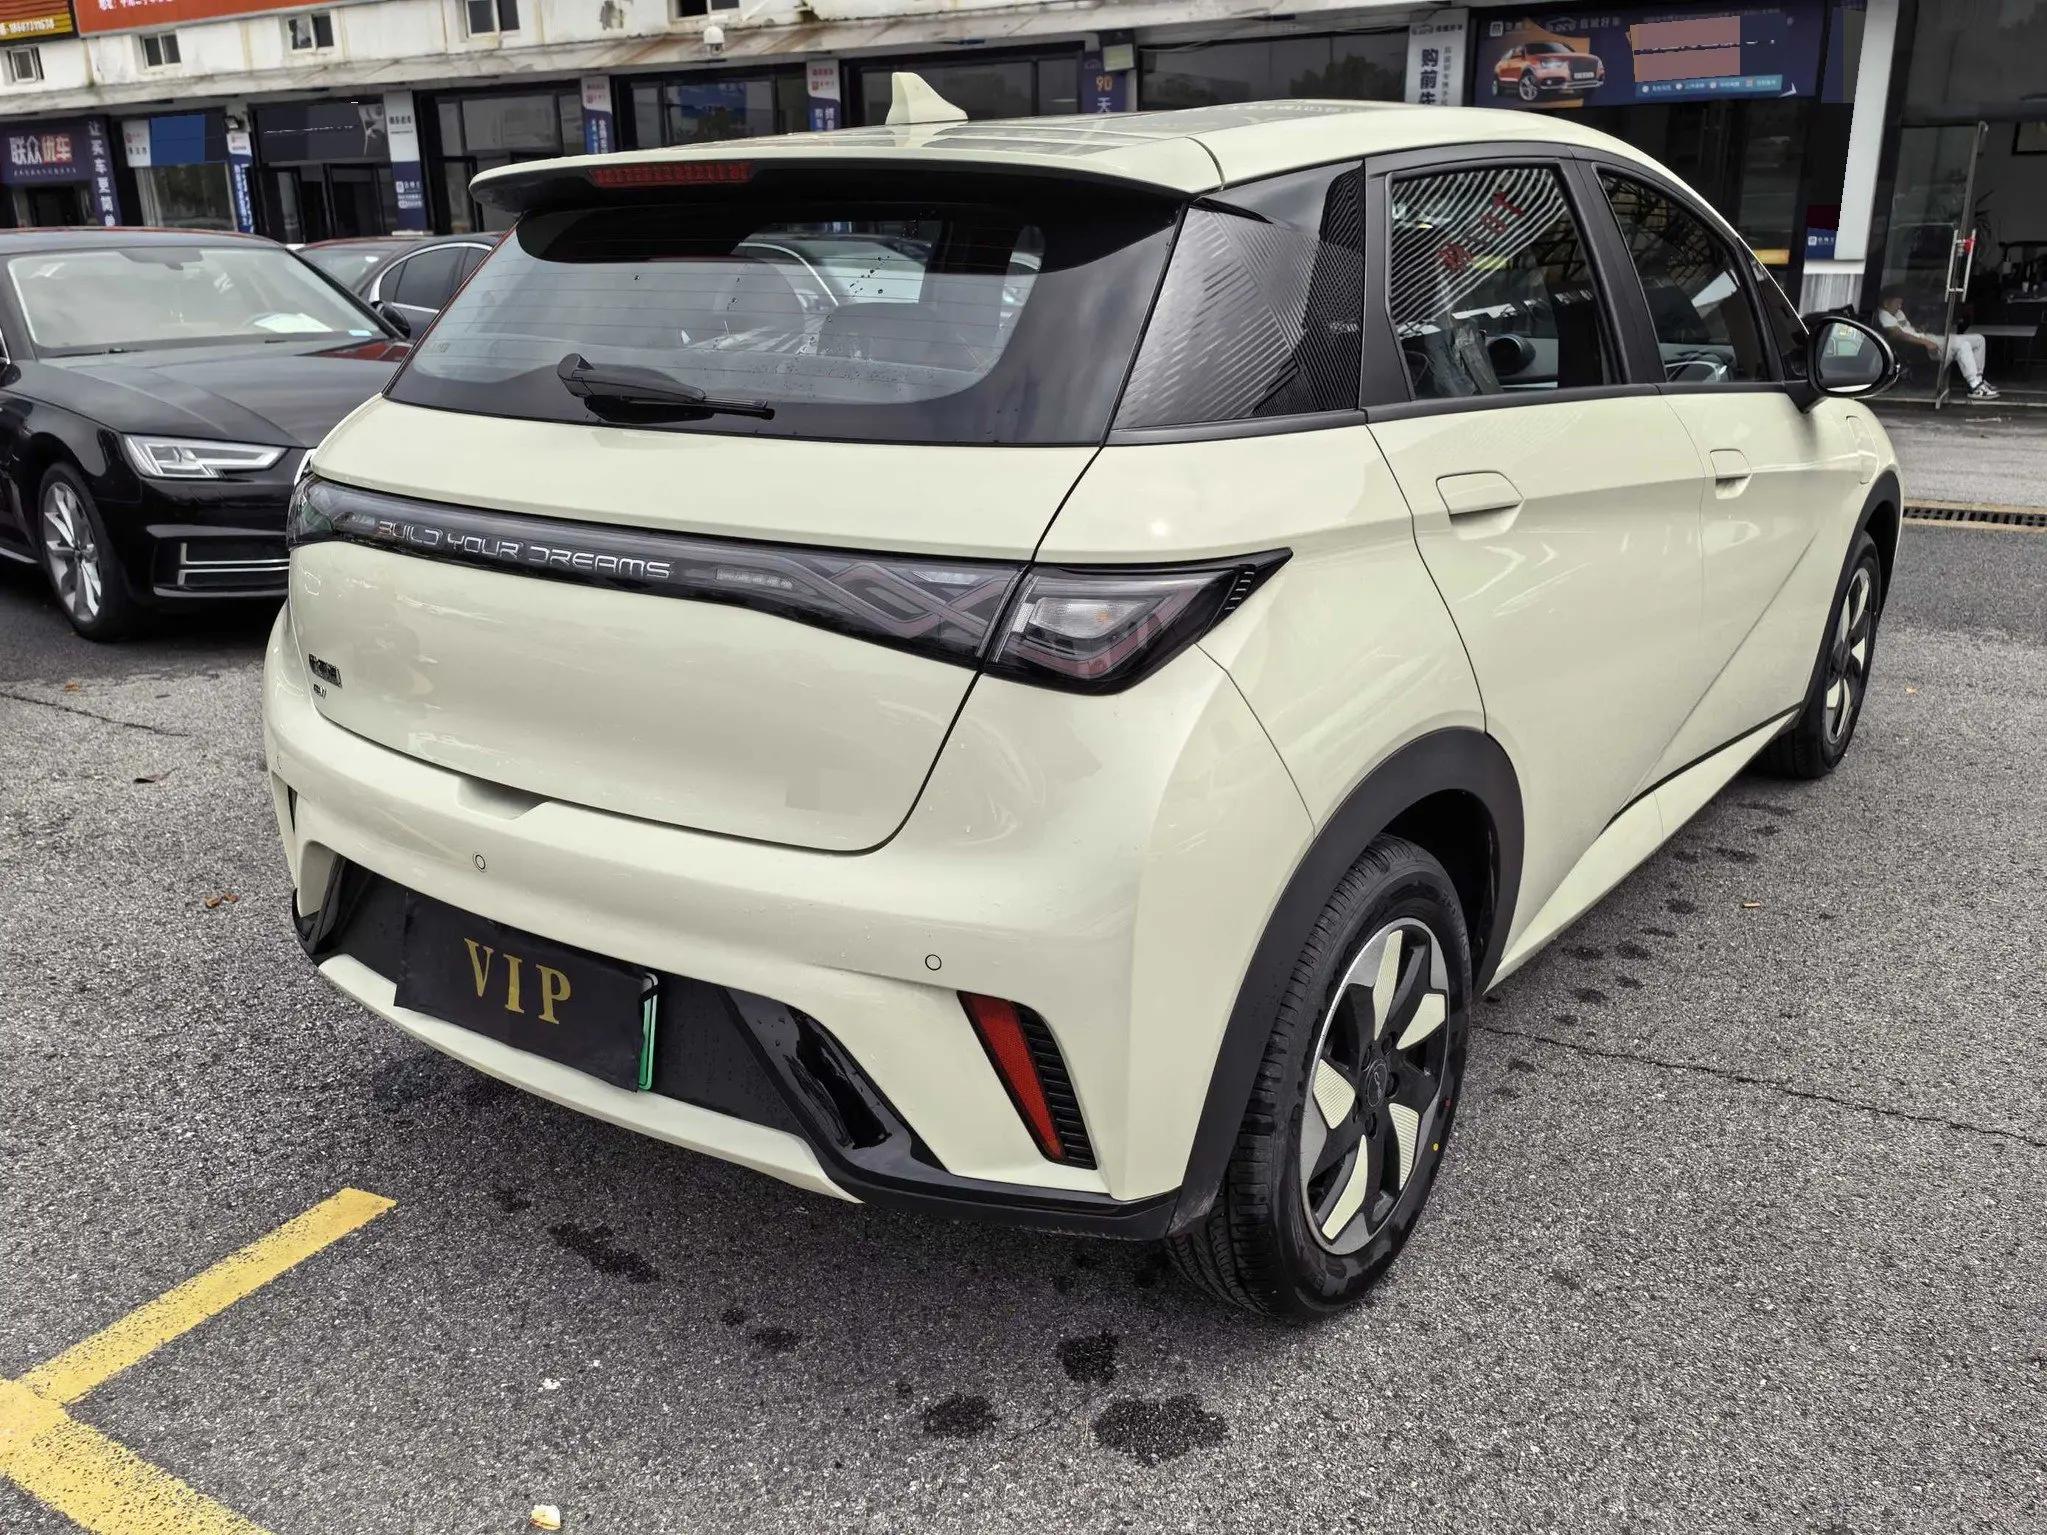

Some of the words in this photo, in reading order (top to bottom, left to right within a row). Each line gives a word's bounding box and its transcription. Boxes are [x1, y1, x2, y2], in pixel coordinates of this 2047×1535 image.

[1096, 75, 1113, 91] 90
[446, 535, 520, 560] YOUR
[528, 545, 671, 579] DREAMS
[463, 937, 572, 1025] VIP
